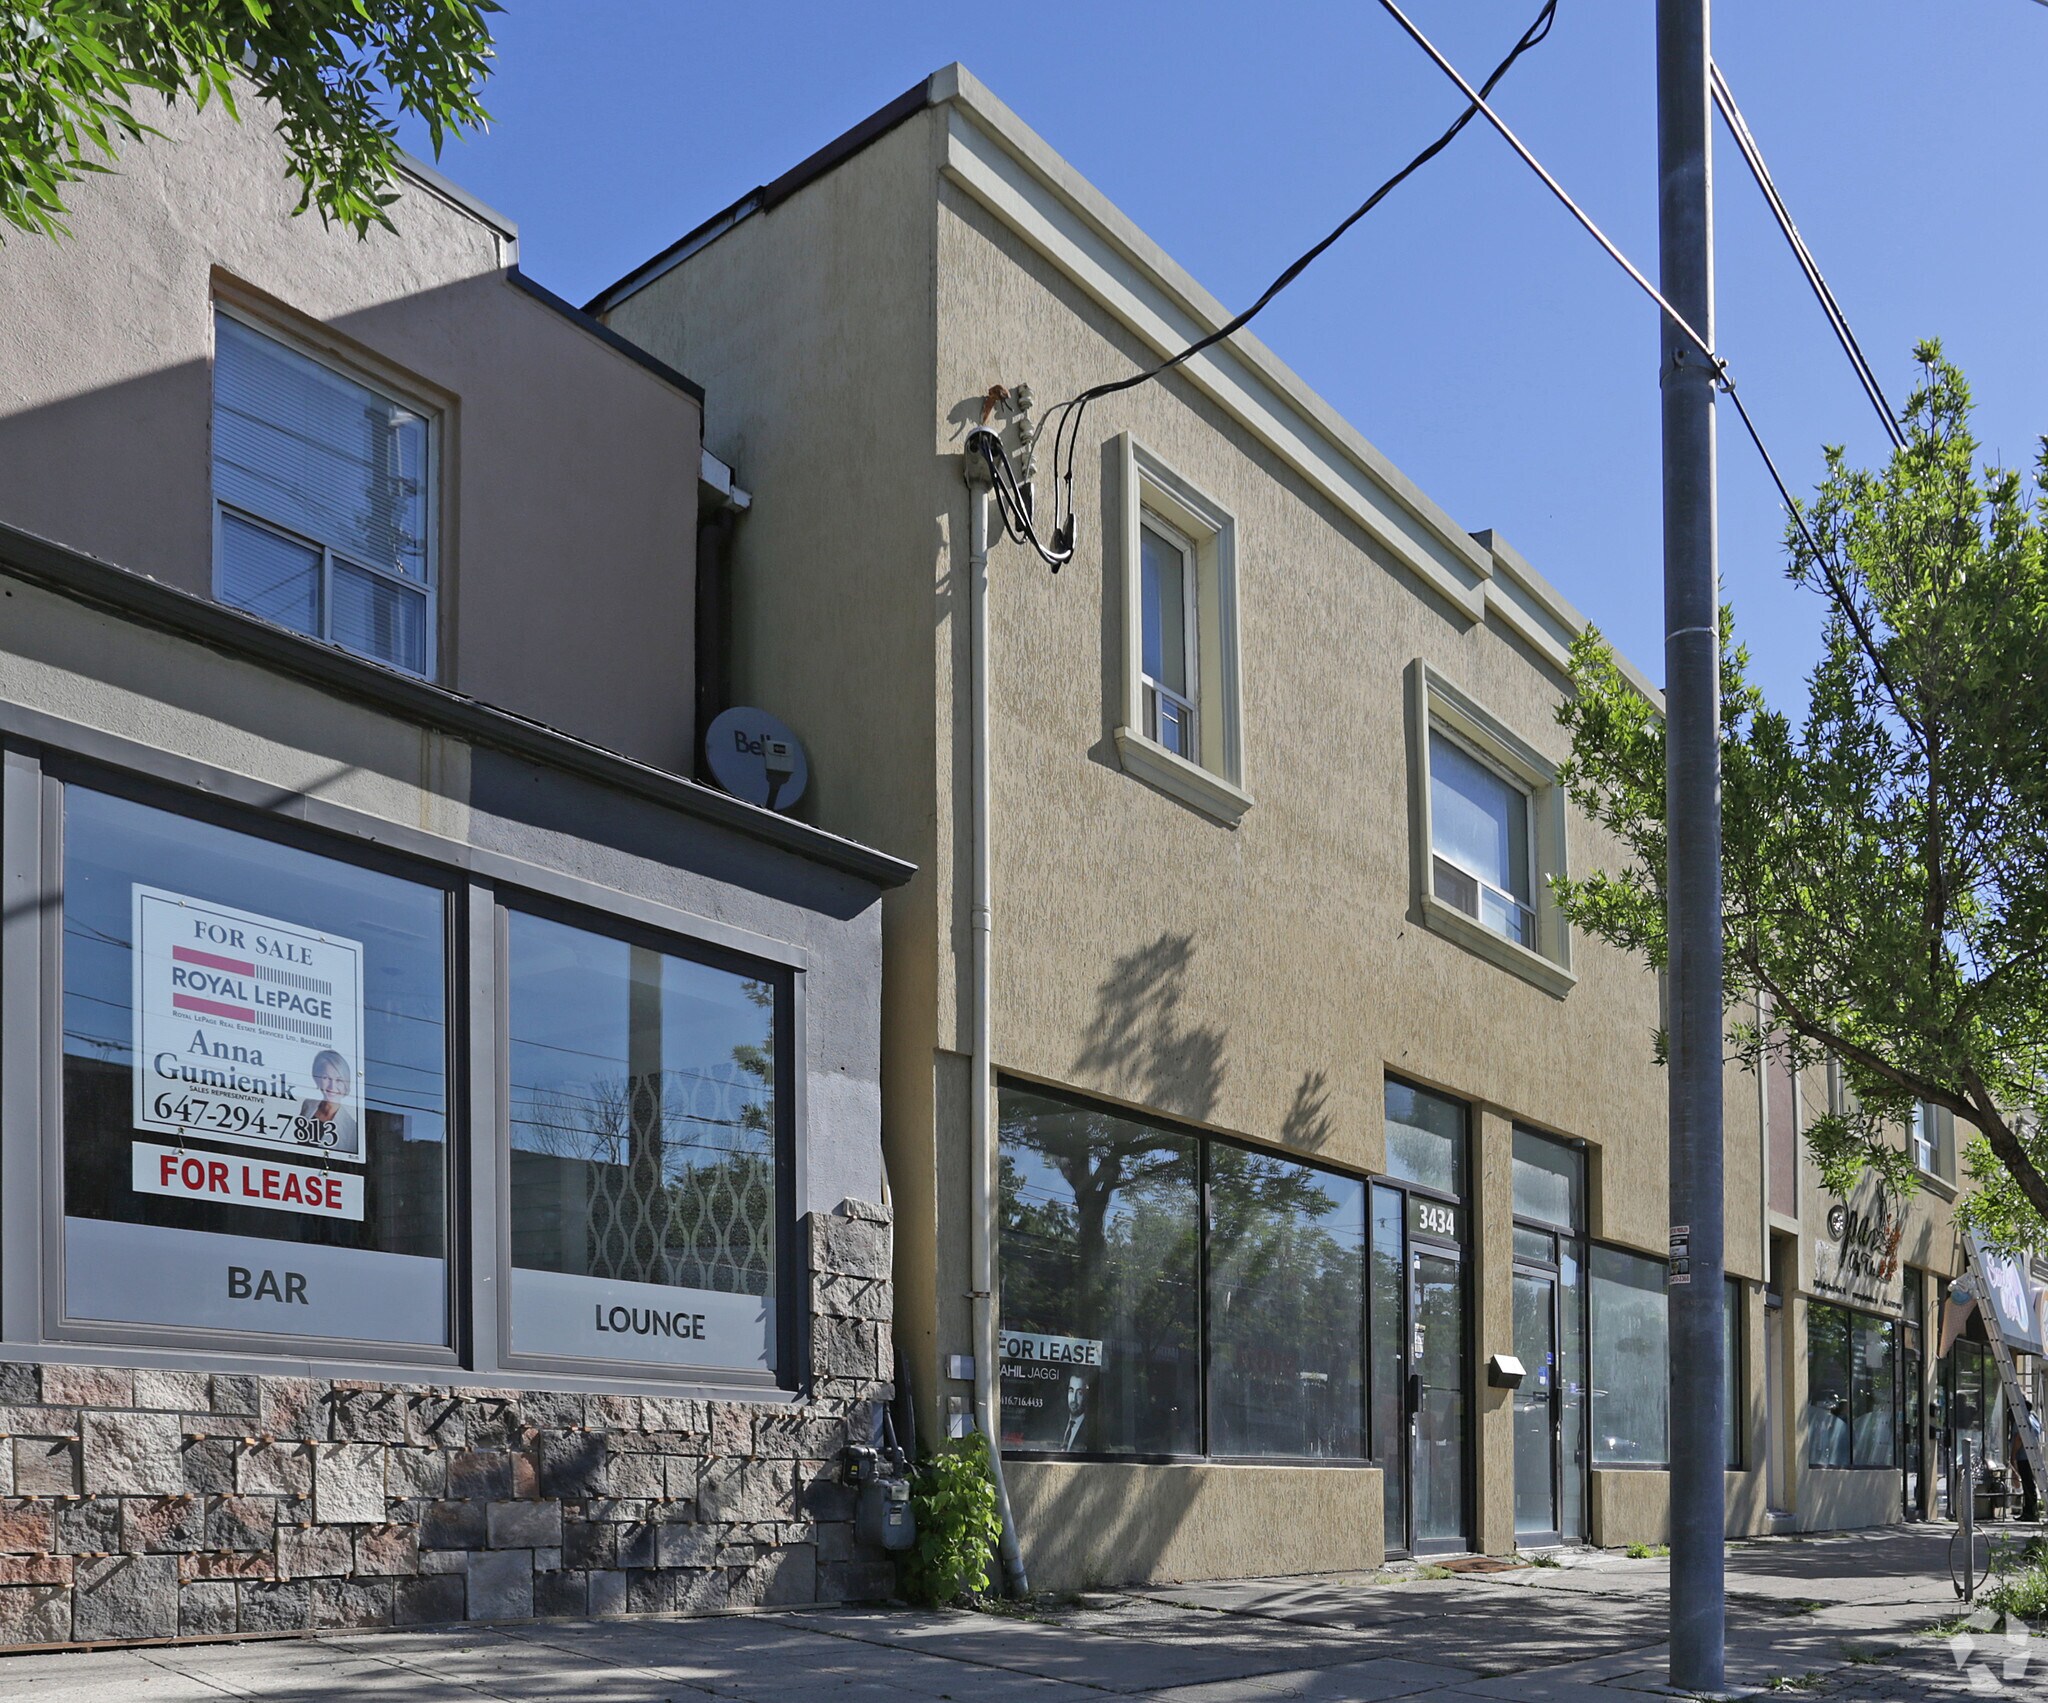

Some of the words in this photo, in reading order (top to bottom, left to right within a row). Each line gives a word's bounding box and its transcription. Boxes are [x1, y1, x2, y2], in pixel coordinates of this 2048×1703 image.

[194, 920, 246, 949] FOR
[255, 936, 313, 966] SALE
[172, 966, 248, 1001] ROYAL
[187, 1029, 265, 1067] Anna
[154, 1052, 298, 1102] Gumienik
[189, 1085, 210, 1095] SALES
[210, 1088, 265, 1104] REPRESENTATIVE
[154, 1092, 339, 1147] 647-294-7813
[160, 1154, 231, 1194] FOR
[242, 1165, 343, 1210] LEASE
[1419, 1204, 1455, 1236] 3434
[228, 1266, 309, 1305] BAR
[596, 1304, 705, 1340] LOUNGE
[1040, 1341, 1096, 1365] LEASE
[999, 1364, 1026, 1378] AHIL
[1027, 1367, 1060, 1381] JAGGI
